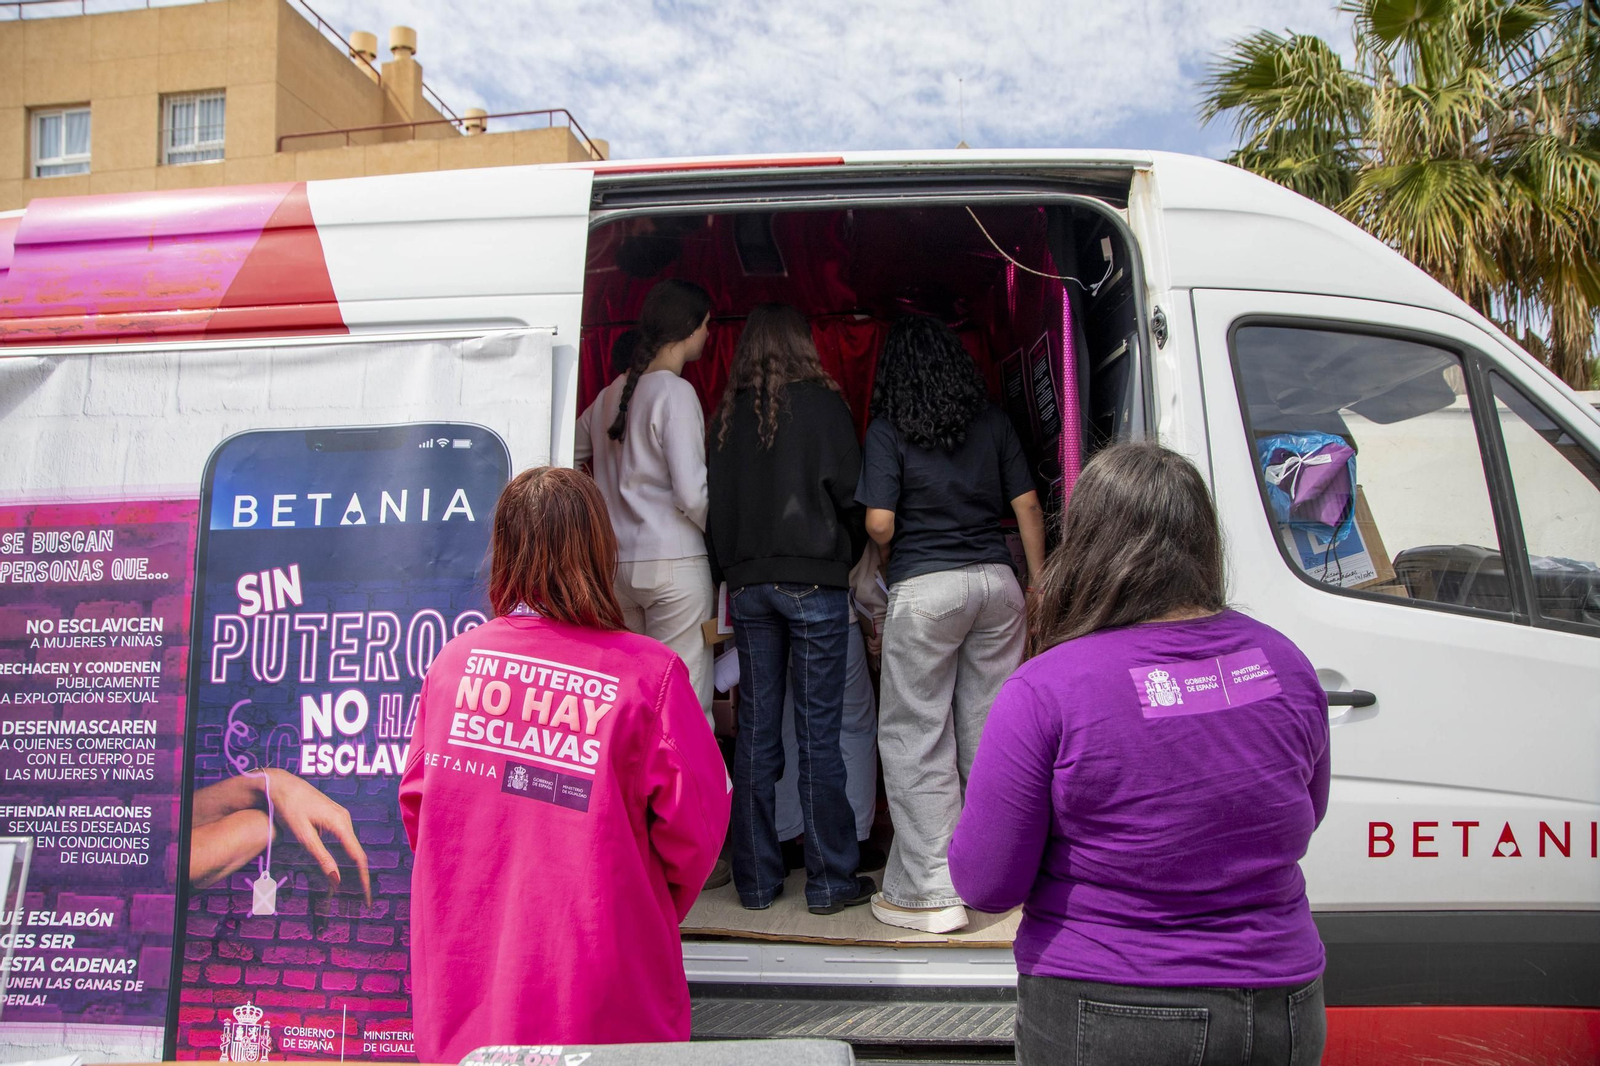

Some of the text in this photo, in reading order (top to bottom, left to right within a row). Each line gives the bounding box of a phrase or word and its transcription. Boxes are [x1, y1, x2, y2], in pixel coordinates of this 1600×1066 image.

[232, 488, 475, 528] BETANIA
[0, 530, 114, 554] SE BUSCAN
[0, 558, 168, 583] PERSONAS QUE...
[237, 563, 302, 616] SIN
[26, 617, 164, 634] NO ESCLAVICEN
[30, 632, 163, 649] A MUJERES Y NIÑAS
[0, 661, 161, 674] RECHACEN Y CONDENEN
[1231, 664, 1260, 676] MINISTERIO
[56, 674, 160, 689] PÚBLICAMENTE
[464, 656, 618, 702] SIN PUTEROS
[1184, 675, 1218, 686] GOBIERNO
[1234, 669, 1269, 684] DE IGUALDAD
[1186, 682, 1220, 692] DE ESPAÑA
[14, 689, 104, 704] EXPLOTACIÓN
[107, 691, 158, 703] SEXUAL
[455, 676, 613, 736] NO HAY
[301, 690, 368, 740] NO
[2, 720, 157, 735] DESENMASCAREN
[0, 737, 156, 752] A QUIENES COMERCIAN
[450, 712, 600, 765] ESCLAVAS
[27, 753, 154, 766] CON EL CUERPO DE
[424, 752, 497, 779] BETANIA
[5, 764, 154, 780] LAS MUJERES Y NIÑAS
[0, 806, 152, 818] EFIENDAN RELACIONES
[8, 821, 150, 834] SEXUALES DESEADAS
[36, 836, 150, 850] EN CONDICIONES
[1368, 821, 1598, 858] BETANI
[60, 852, 148, 865] DE IGUALDAD
[27, 908, 114, 927] ESLABÓN
[39, 934, 75, 949] SER
[0, 957, 137, 974] ESTA CADENA?
[5, 978, 144, 992] UNEN LAS GANAS DE
[284, 1026, 335, 1038] GOBIERNO
[283, 1039, 334, 1052] DE ESPAÑA
[364, 1043, 376, 1052] DE
